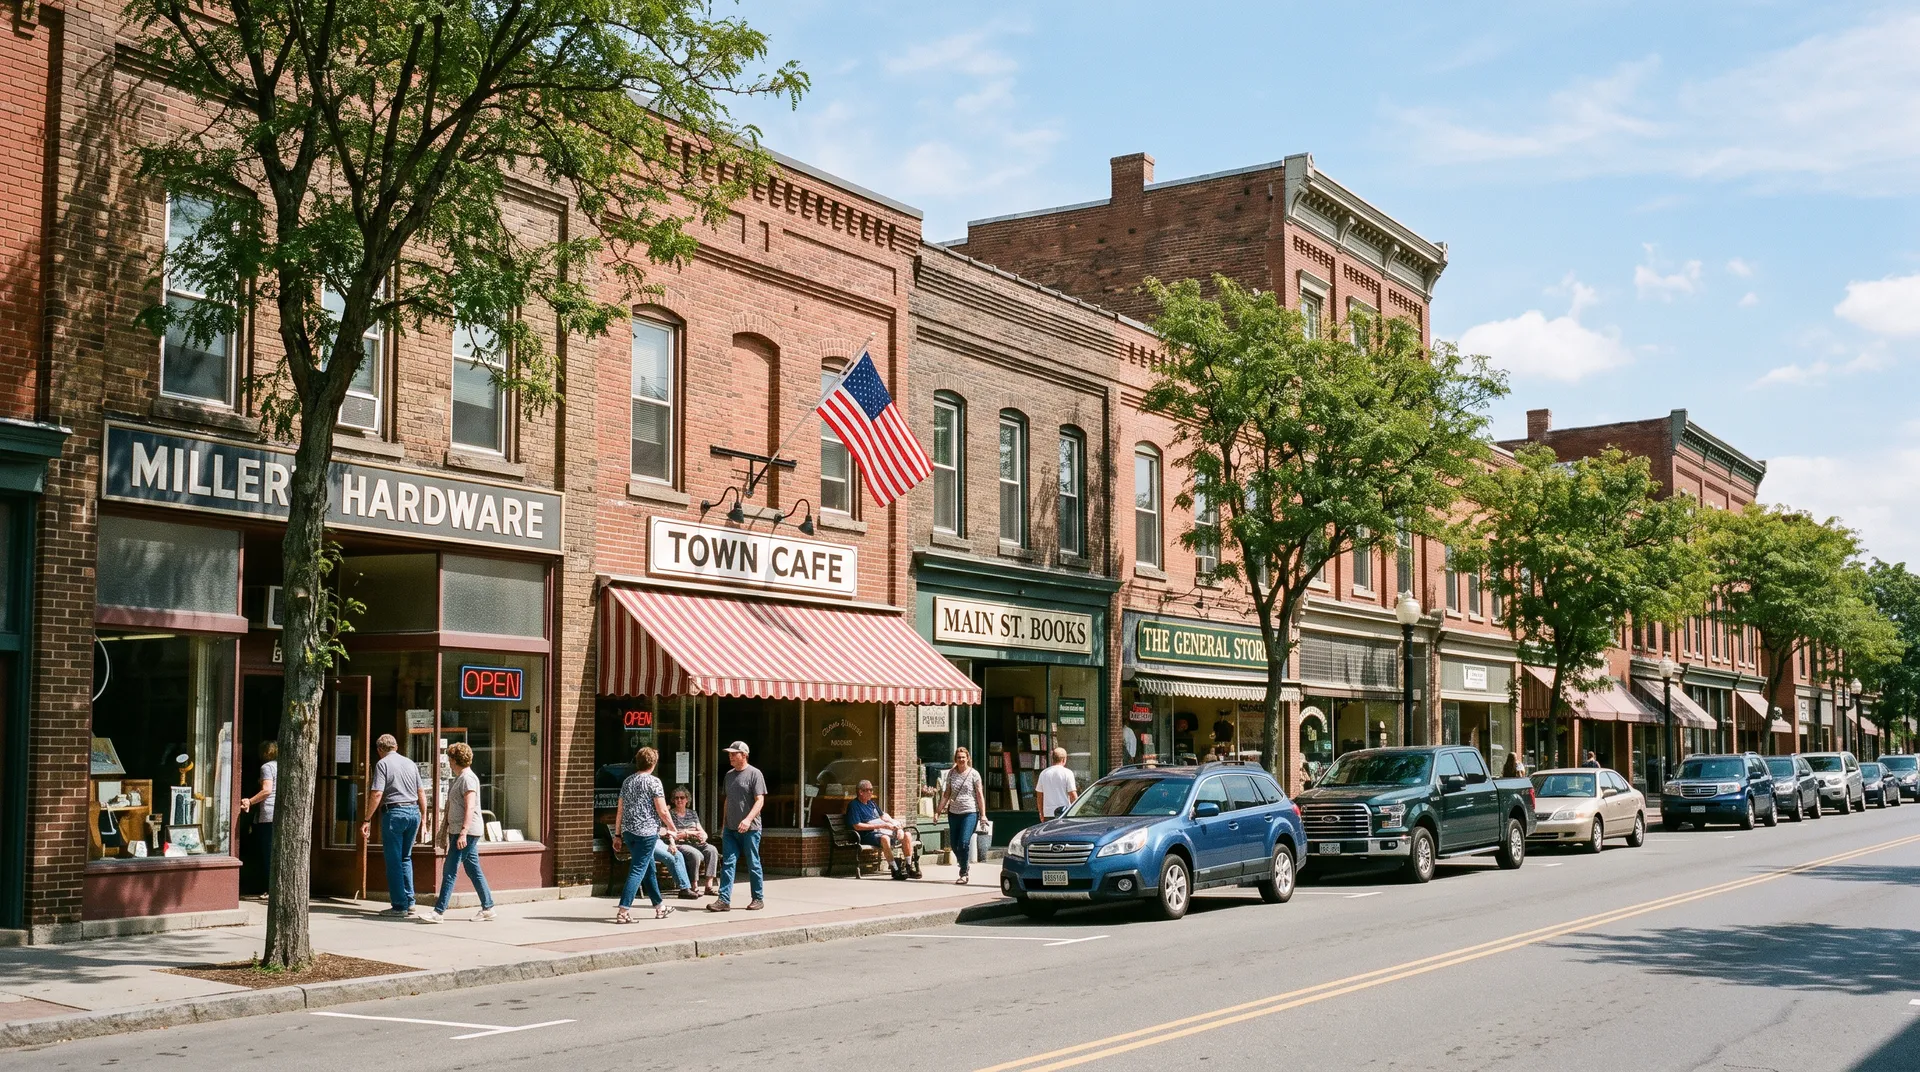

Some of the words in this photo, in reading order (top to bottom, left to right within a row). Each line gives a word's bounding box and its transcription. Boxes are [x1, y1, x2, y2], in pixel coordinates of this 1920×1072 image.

[131, 441, 297, 507] MILLER'
[341, 473, 544, 540] HARDWARE
[668, 530, 758, 573] TOWN
[771, 546, 843, 584] CAFE
[944, 607, 994, 636] MAIN
[1000, 613, 1025, 639] ST.
[1030, 617, 1086, 645] BOOKS
[1143, 627, 1170, 653] THE
[1173, 631, 1231, 659] GENERAL
[464, 670, 520, 697] OPEN
[624, 711, 653, 726] OPEN
